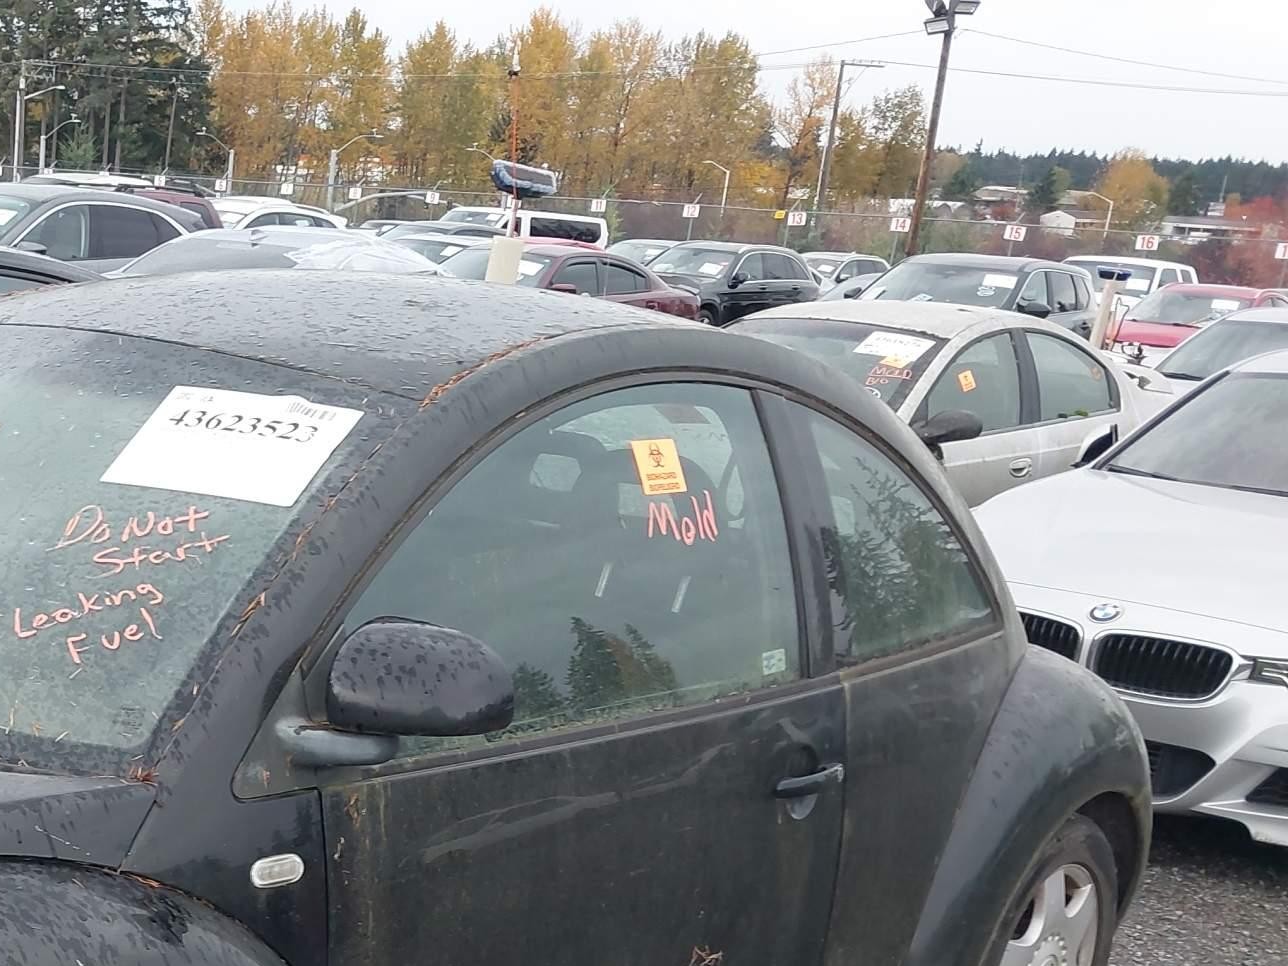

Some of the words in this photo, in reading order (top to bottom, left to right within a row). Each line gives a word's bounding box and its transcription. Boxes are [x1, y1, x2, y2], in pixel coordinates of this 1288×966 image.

[168, 408, 321, 444] 43623523
[45, 504, 111, 552] Do
[121, 505, 210, 542] Not
[86, 531, 231, 579] Start
[13, 582, 164, 638] Leaking
[66, 607, 163, 664] Fuel
